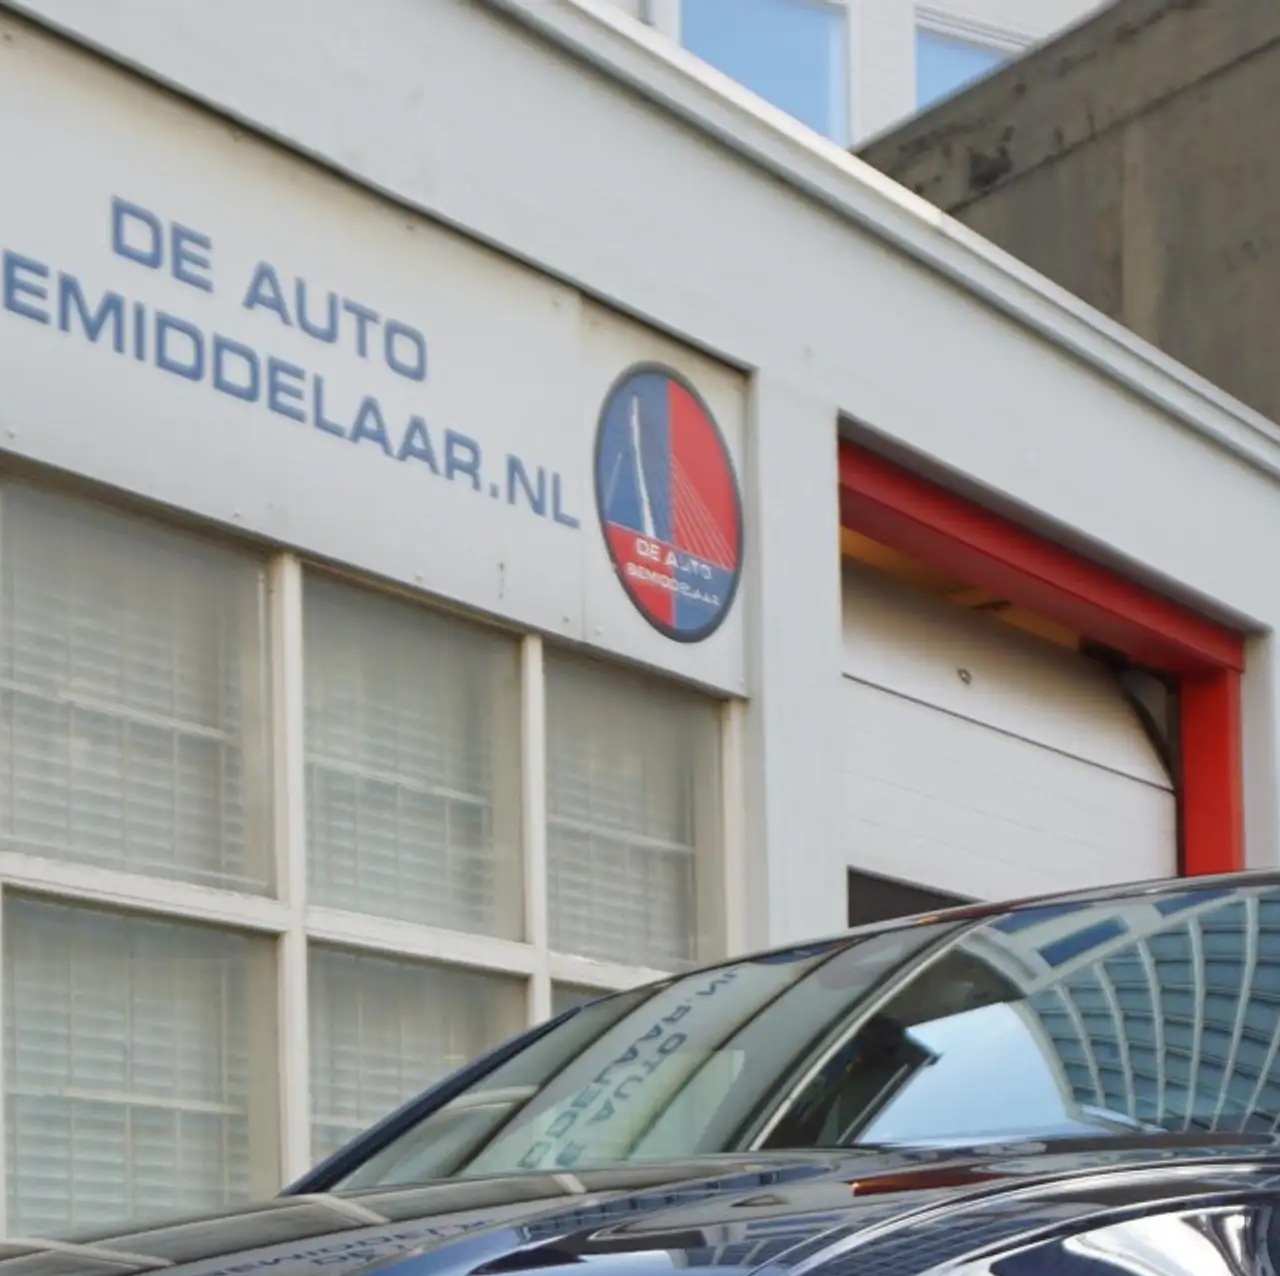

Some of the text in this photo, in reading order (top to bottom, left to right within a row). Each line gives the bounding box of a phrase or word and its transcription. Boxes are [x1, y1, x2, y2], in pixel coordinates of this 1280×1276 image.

[111, 194, 429, 383] DE AUTO
[635, 537, 661, 562] DE
